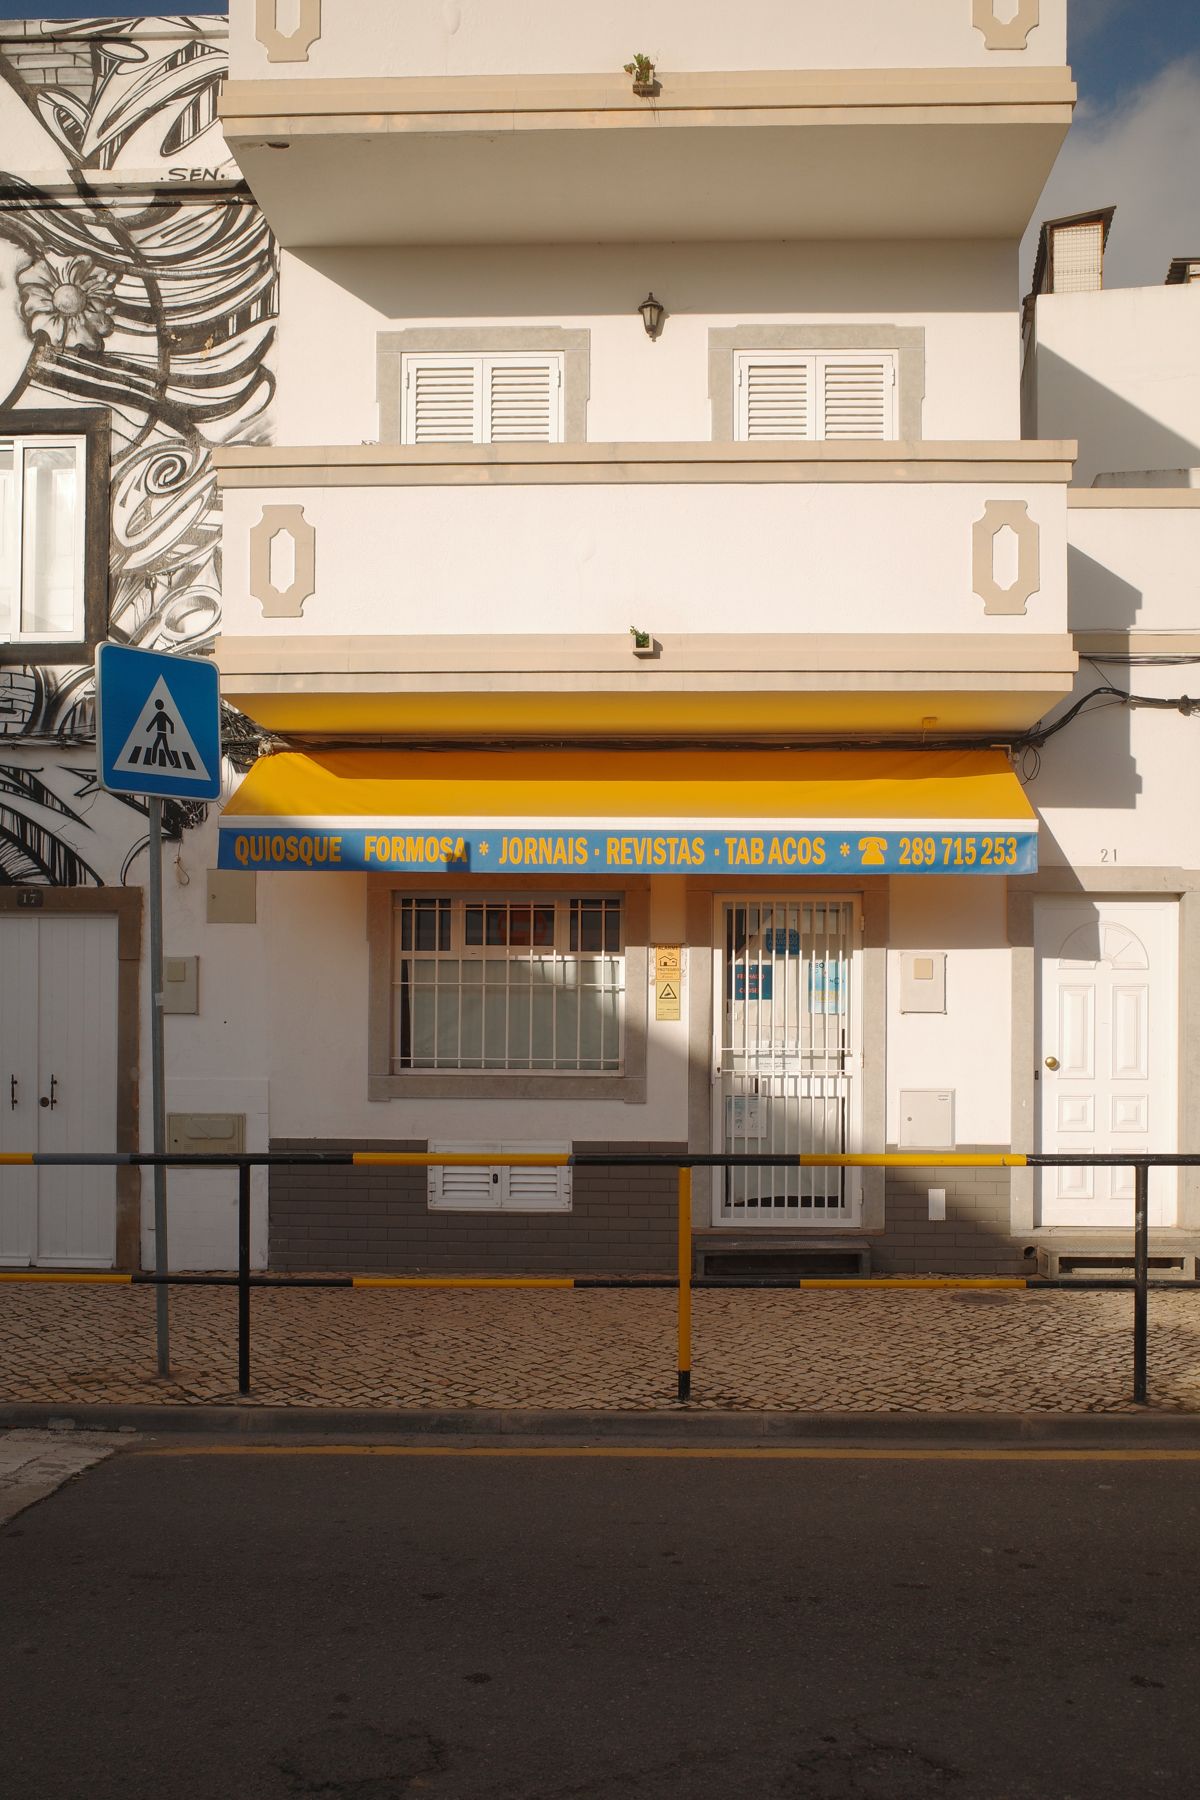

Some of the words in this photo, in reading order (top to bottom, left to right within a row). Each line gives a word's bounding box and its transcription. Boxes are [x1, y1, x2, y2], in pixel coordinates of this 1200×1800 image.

[235, 835, 342, 866] QUIOSQUE
[364, 836, 467, 864] FORMOSA
[499, 837, 588, 865] JORNAIS
[606, 837, 705, 865] REVISTAS
[725, 837, 826, 865] TABACOS
[899, 837, 936, 865] 289
[942, 837, 977, 865] 715
[981, 837, 1018, 865] 253
[1100, 848, 1117, 863] 21
[23, 893, 37, 904] 17
